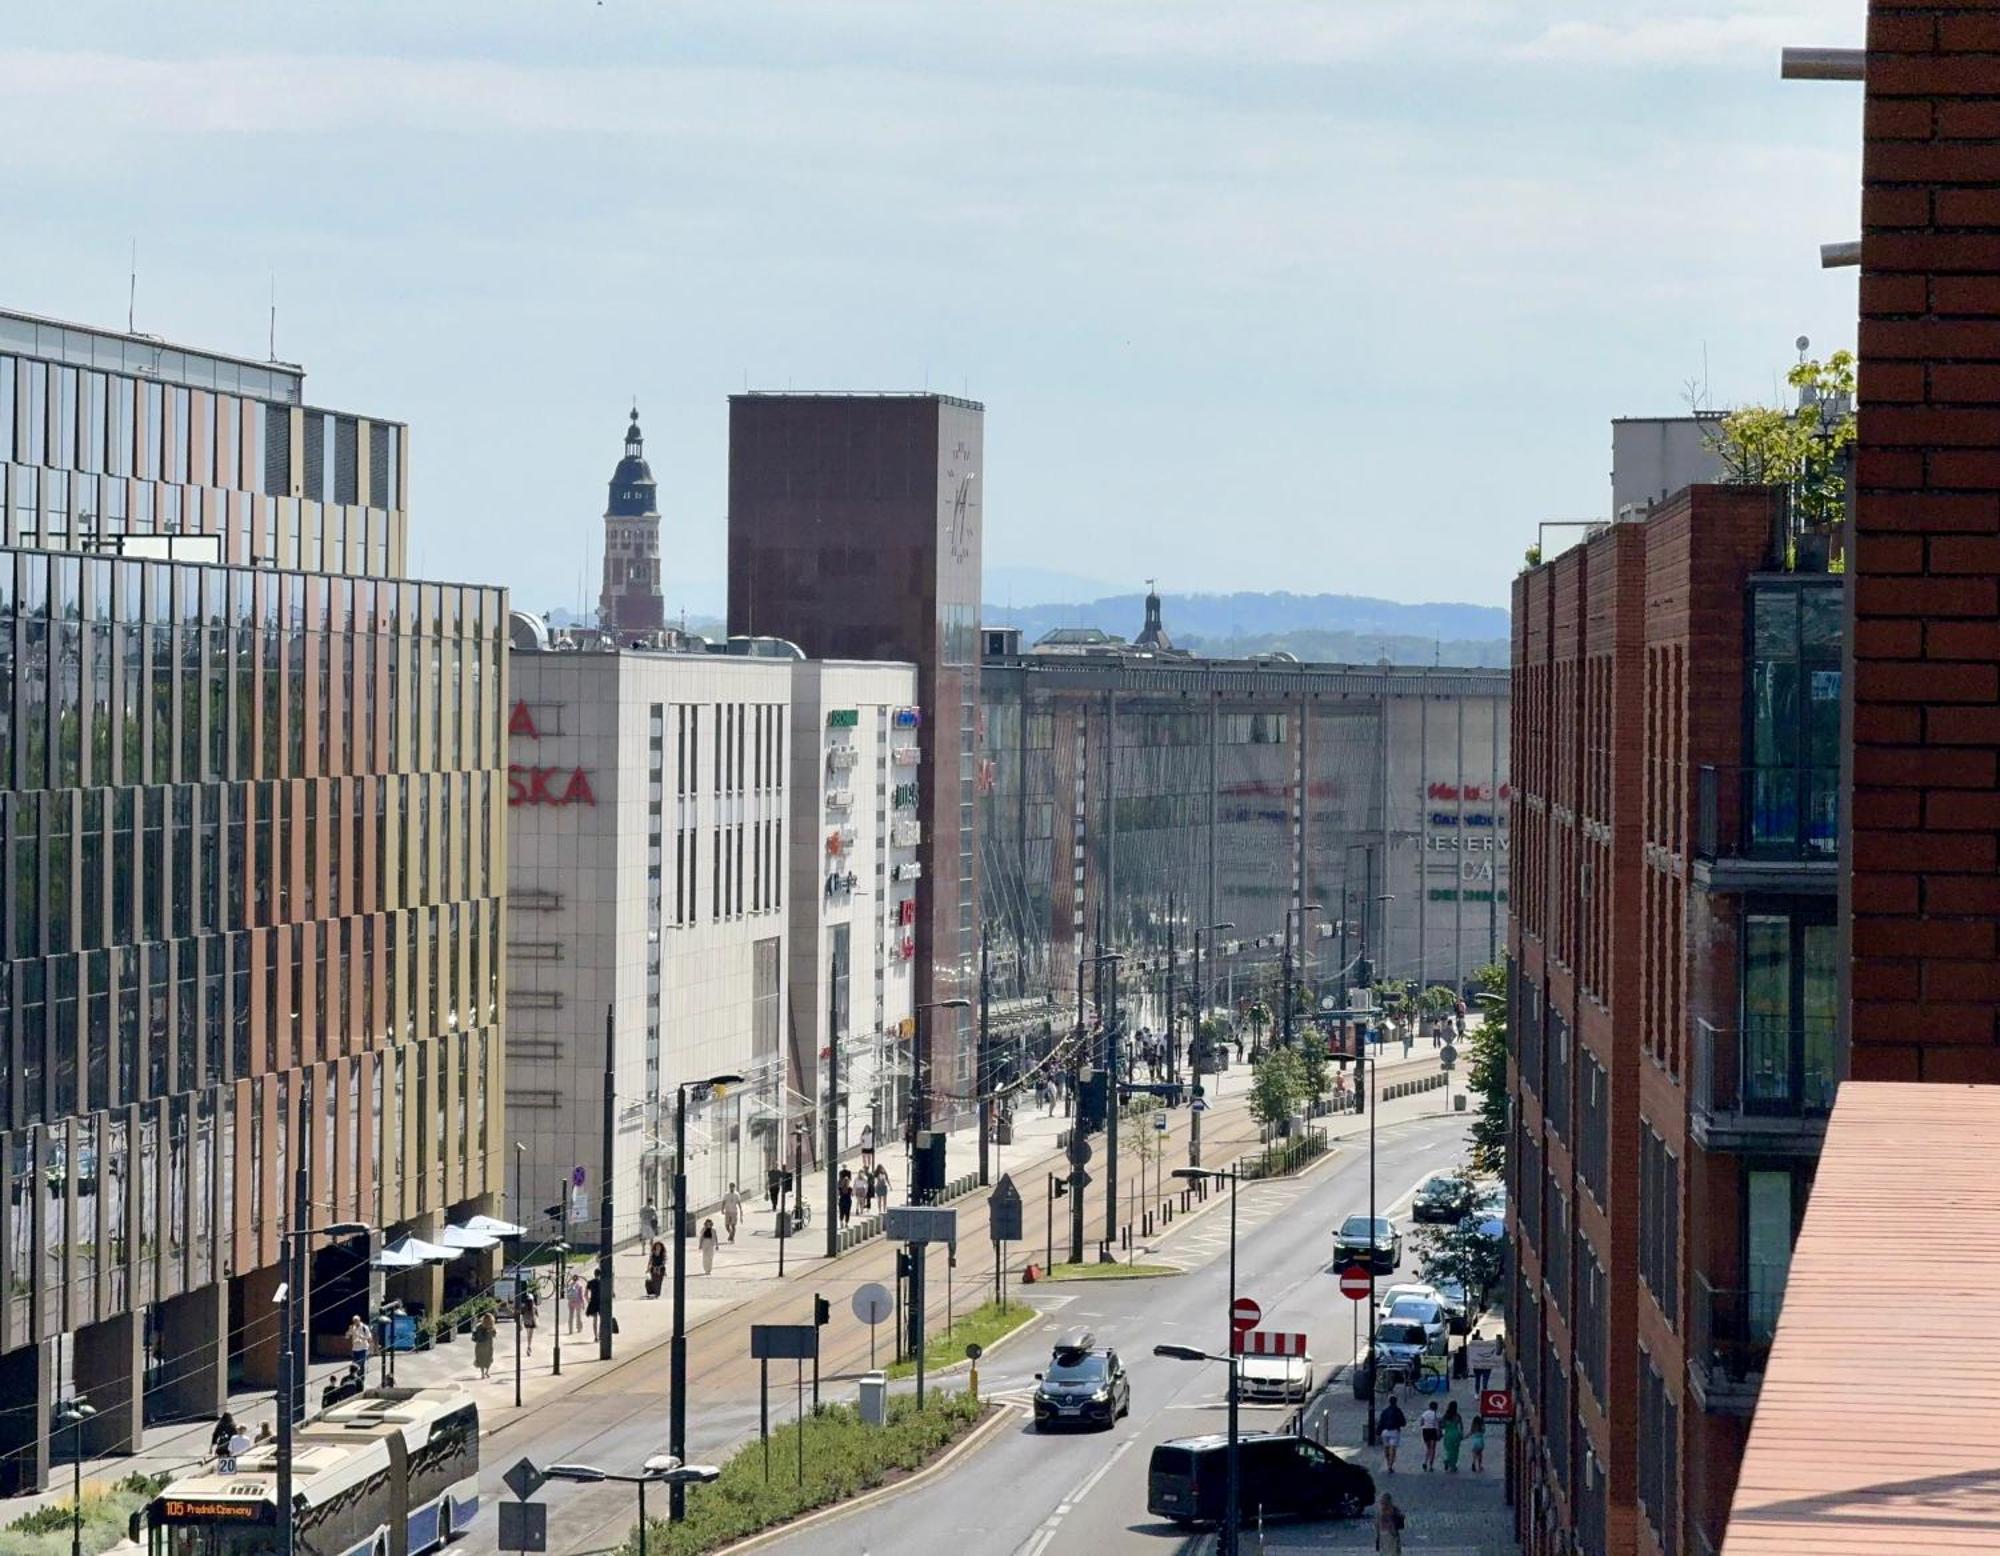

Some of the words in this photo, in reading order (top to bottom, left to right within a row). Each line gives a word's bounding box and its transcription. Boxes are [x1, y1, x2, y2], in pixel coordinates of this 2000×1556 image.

[508, 765, 595, 807] SKA
[1489, 1394, 1506, 1409] Q
[220, 1459, 234, 1473] 20
[167, 1501, 184, 1516] 105
